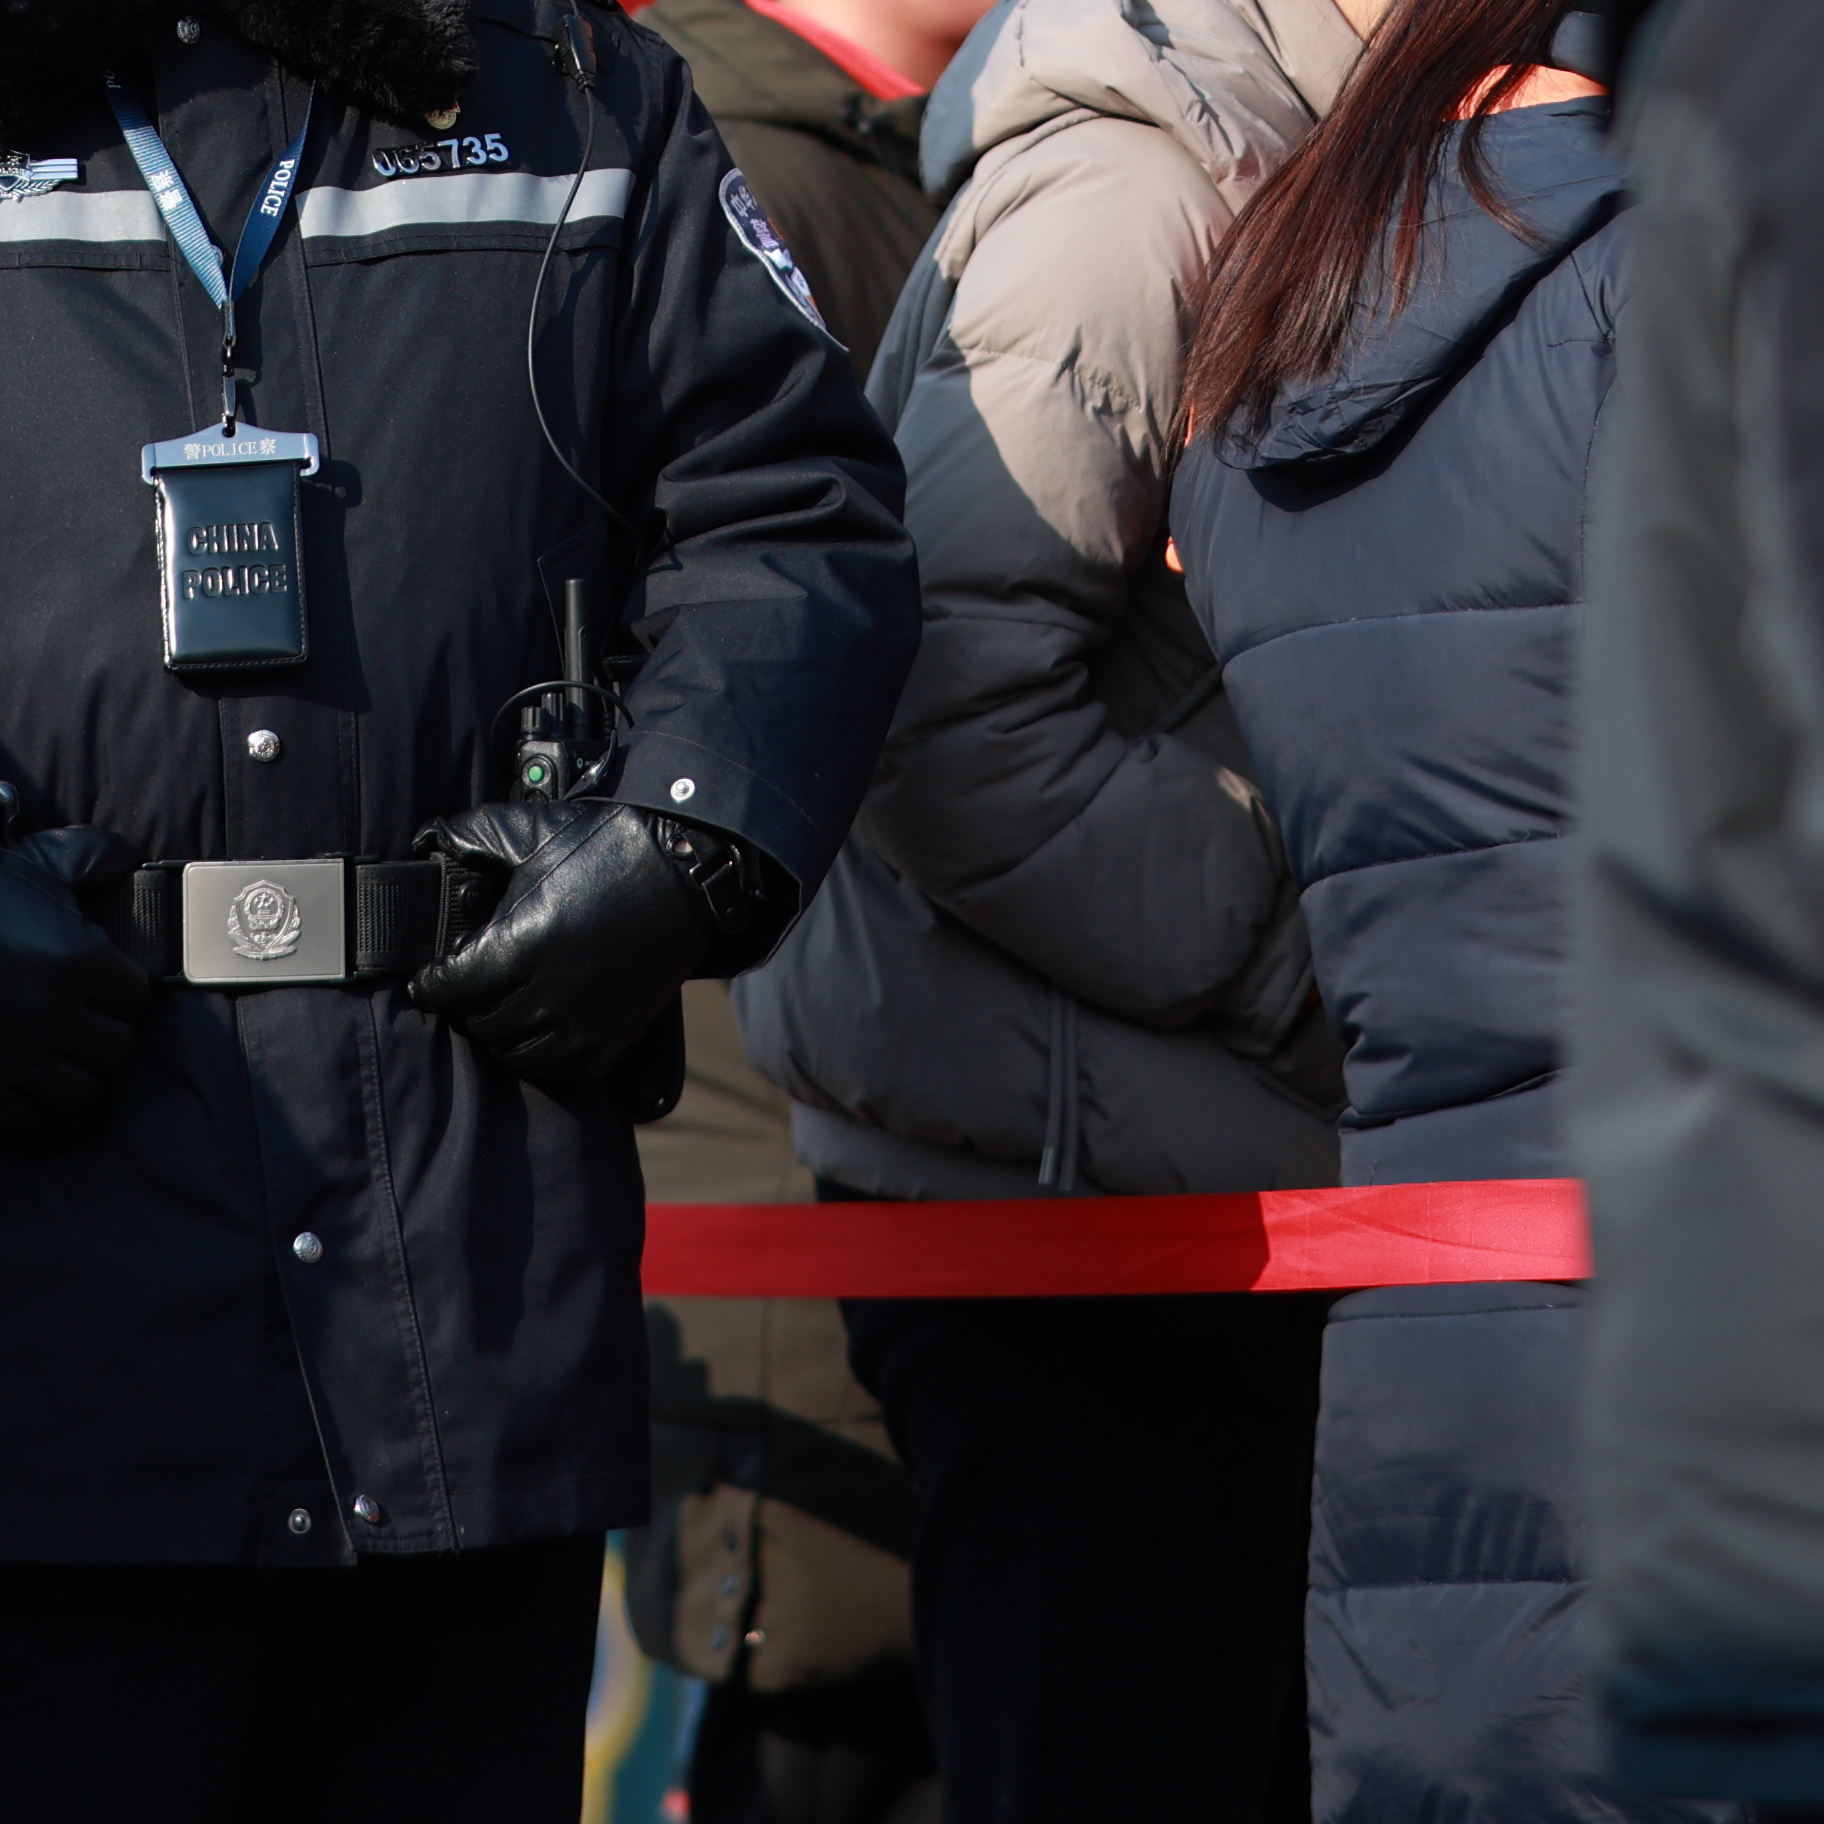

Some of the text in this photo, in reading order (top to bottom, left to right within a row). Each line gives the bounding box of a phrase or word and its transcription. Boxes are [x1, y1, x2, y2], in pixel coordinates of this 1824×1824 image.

[259, 159, 295, 217] POLICE
[187, 522, 279, 555] CHINA
[182, 563, 288, 600] POLICE
